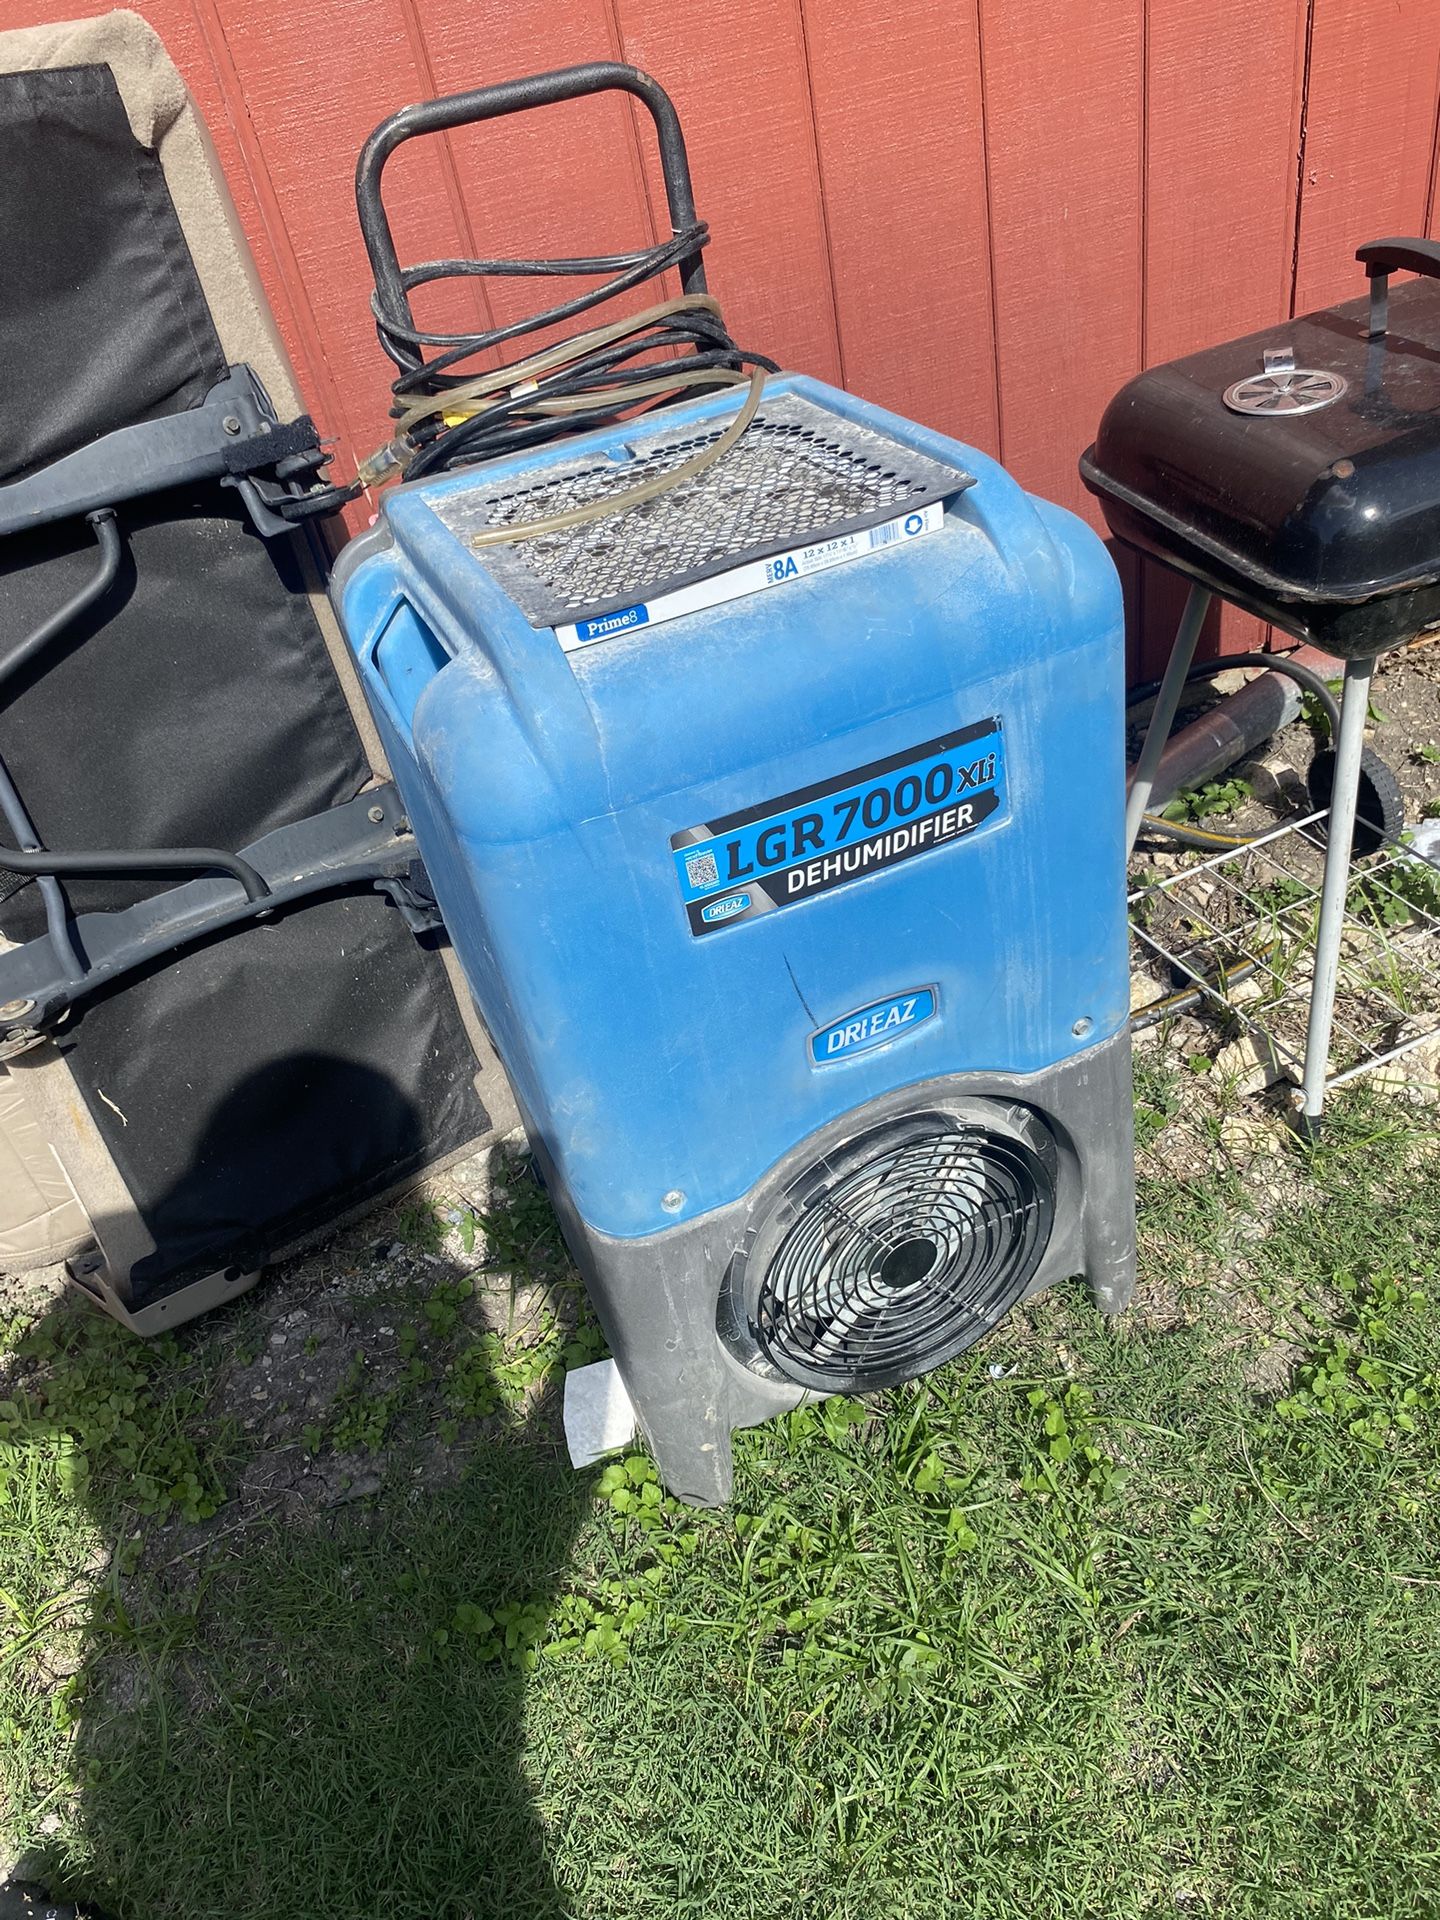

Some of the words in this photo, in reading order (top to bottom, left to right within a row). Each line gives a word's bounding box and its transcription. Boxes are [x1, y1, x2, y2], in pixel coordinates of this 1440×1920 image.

[803, 549, 816, 560] 12
[826, 541, 839, 552] 12
[773, 556, 799, 581] 8A
[586, 610, 638, 637] Prime8
[726, 812, 826, 881] LGR
[832, 762, 955, 842] 7000
[787, 803, 975, 895] DEHUMIDIFIER
